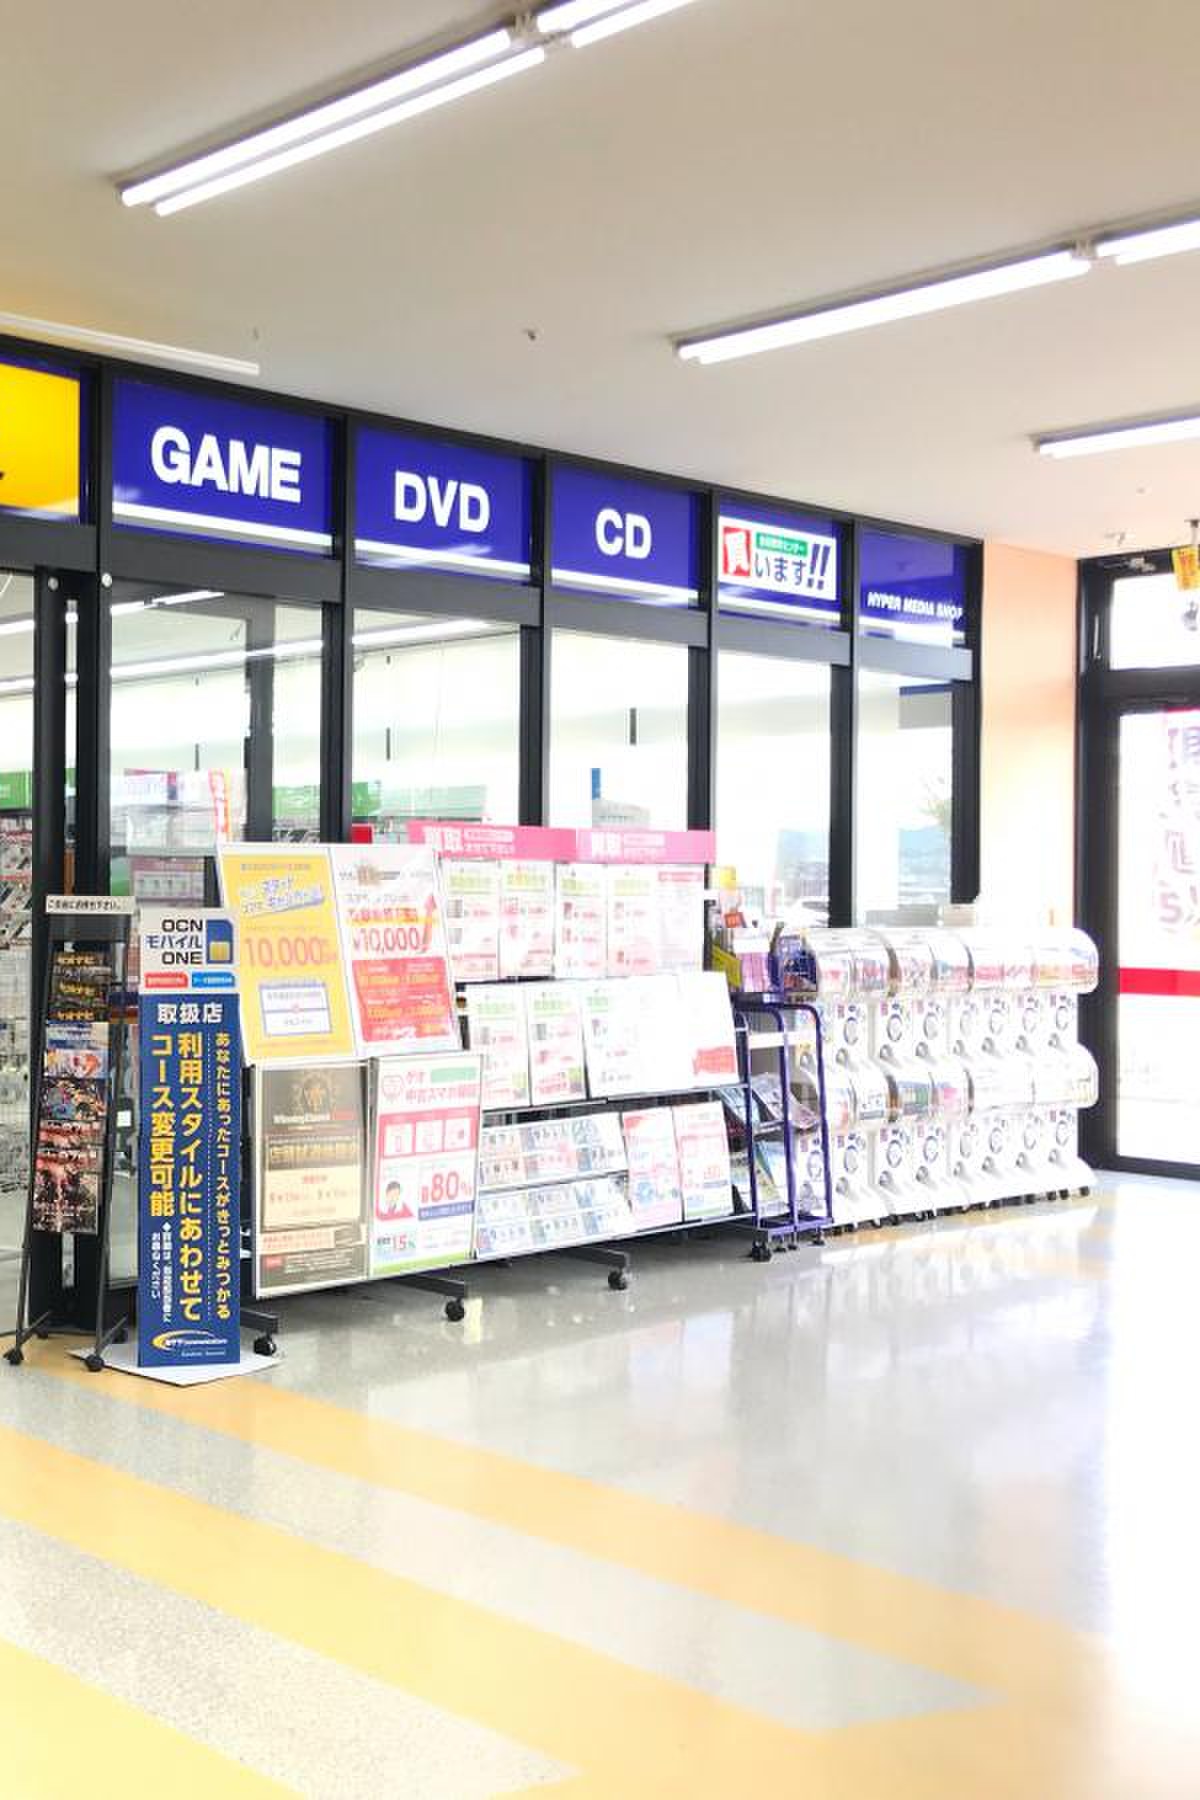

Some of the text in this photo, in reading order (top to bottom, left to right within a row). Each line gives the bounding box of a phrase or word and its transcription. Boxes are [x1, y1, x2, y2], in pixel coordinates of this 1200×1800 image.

[150, 426, 302, 503] GAME
[393, 470, 490, 533] DVD
[594, 508, 652, 560] CD
[866, 591, 963, 620] HYPER MEDIA SHOP
[145, 934, 203, 950] モバイル
[161, 918, 204, 933] OCN
[161, 950, 203, 966] ONE
[157, 1002, 224, 1025] 取扱店
[149, 1033, 176, 1217] コース変更可能
[177, 1032, 203, 1322] 利用スタイルにあわせて
